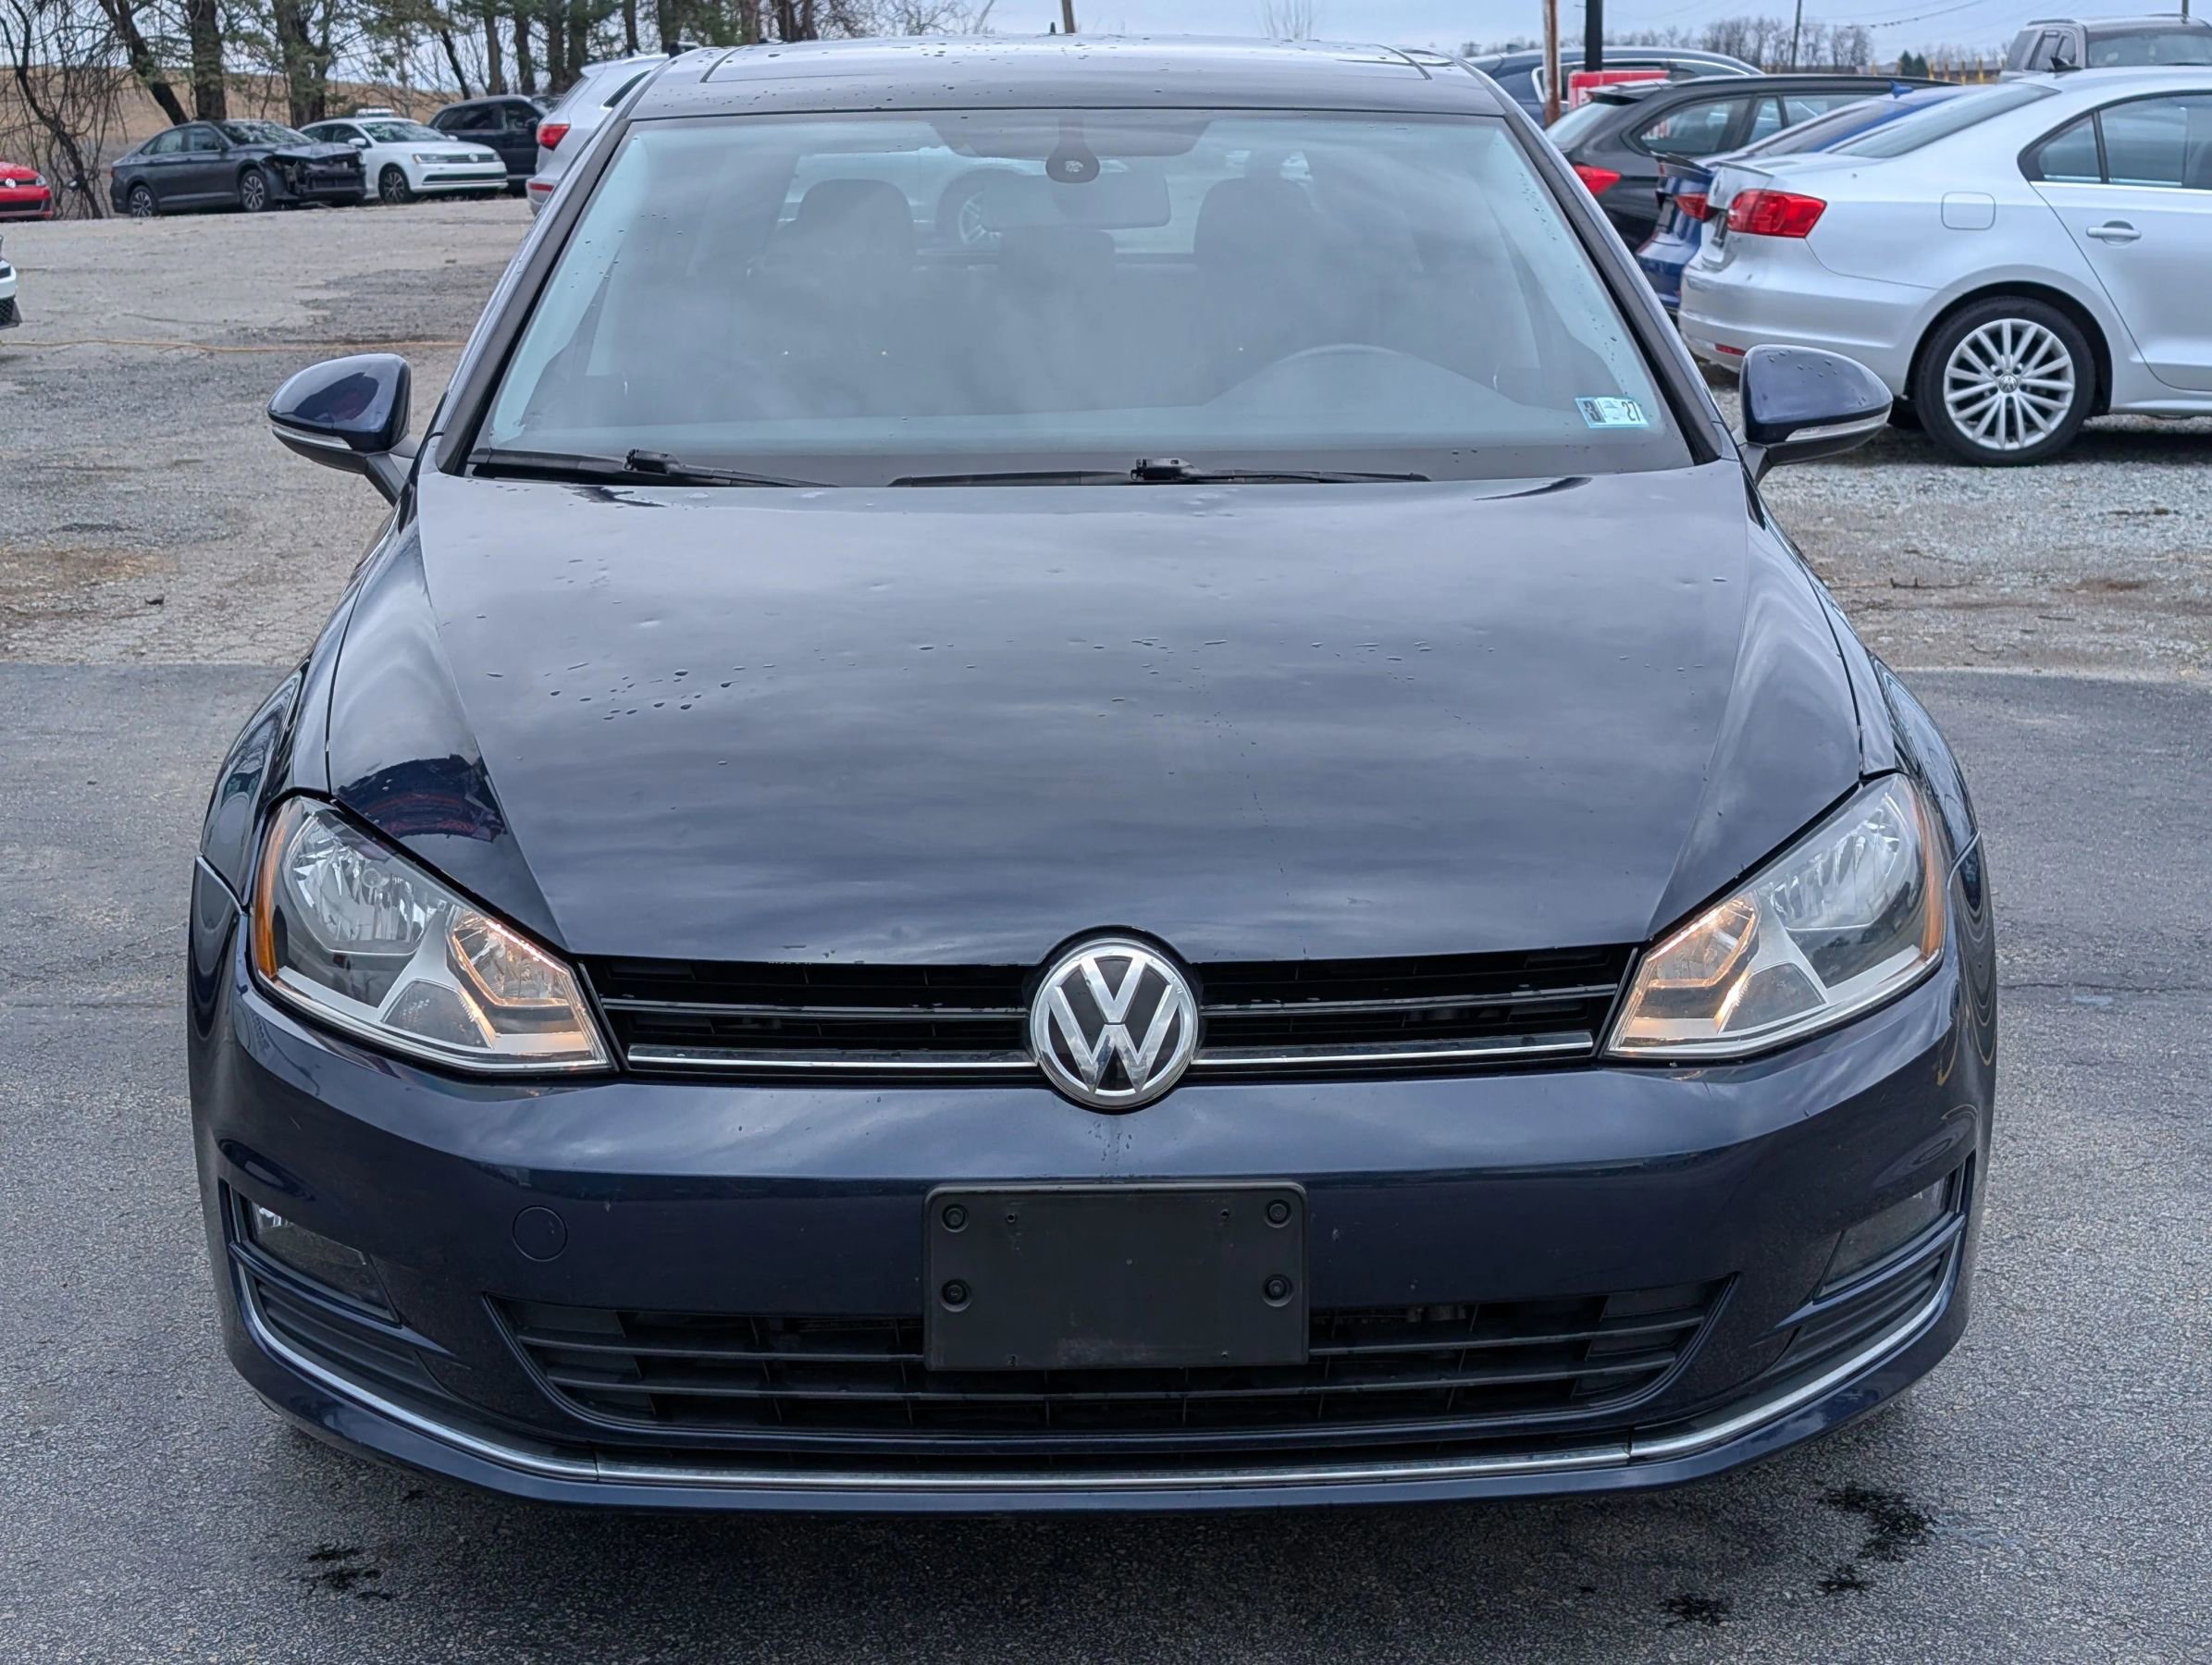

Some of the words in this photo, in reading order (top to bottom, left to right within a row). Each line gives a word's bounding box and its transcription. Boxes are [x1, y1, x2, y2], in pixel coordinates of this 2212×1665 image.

[1583, 401, 1601, 422] 3
[1621, 401, 1641, 422] 27
[1037, 950, 1190, 1099] VW
